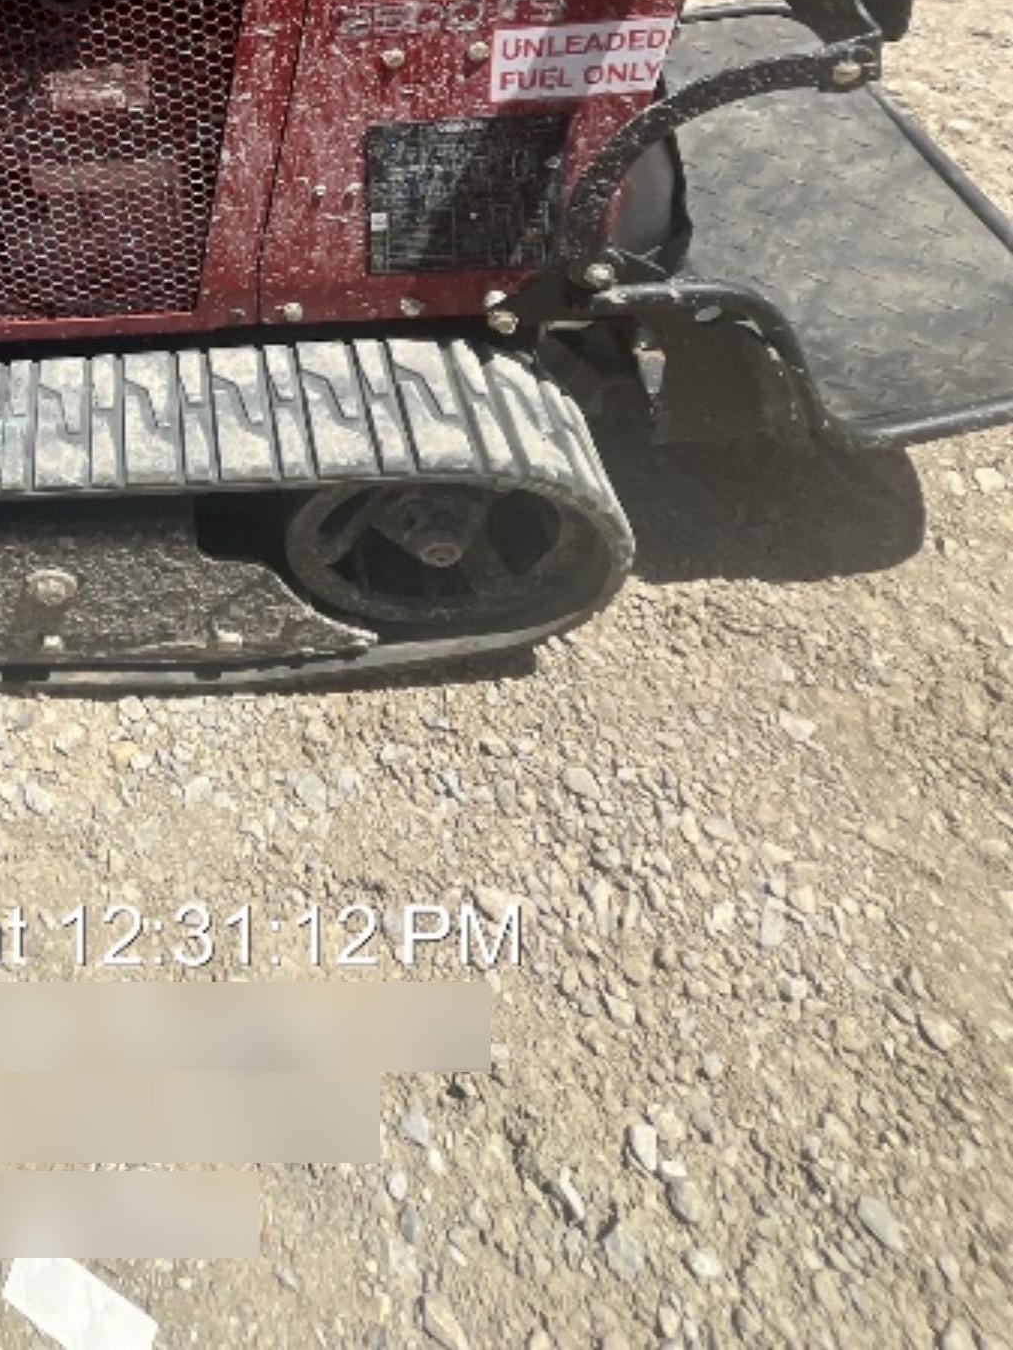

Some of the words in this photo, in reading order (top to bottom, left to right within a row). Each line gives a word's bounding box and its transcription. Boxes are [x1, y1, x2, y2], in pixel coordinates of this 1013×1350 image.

[501, 28, 667, 61] UNLEADED
[498, 66, 573, 91] FUEL
[583, 61, 662, 86] ONLY
